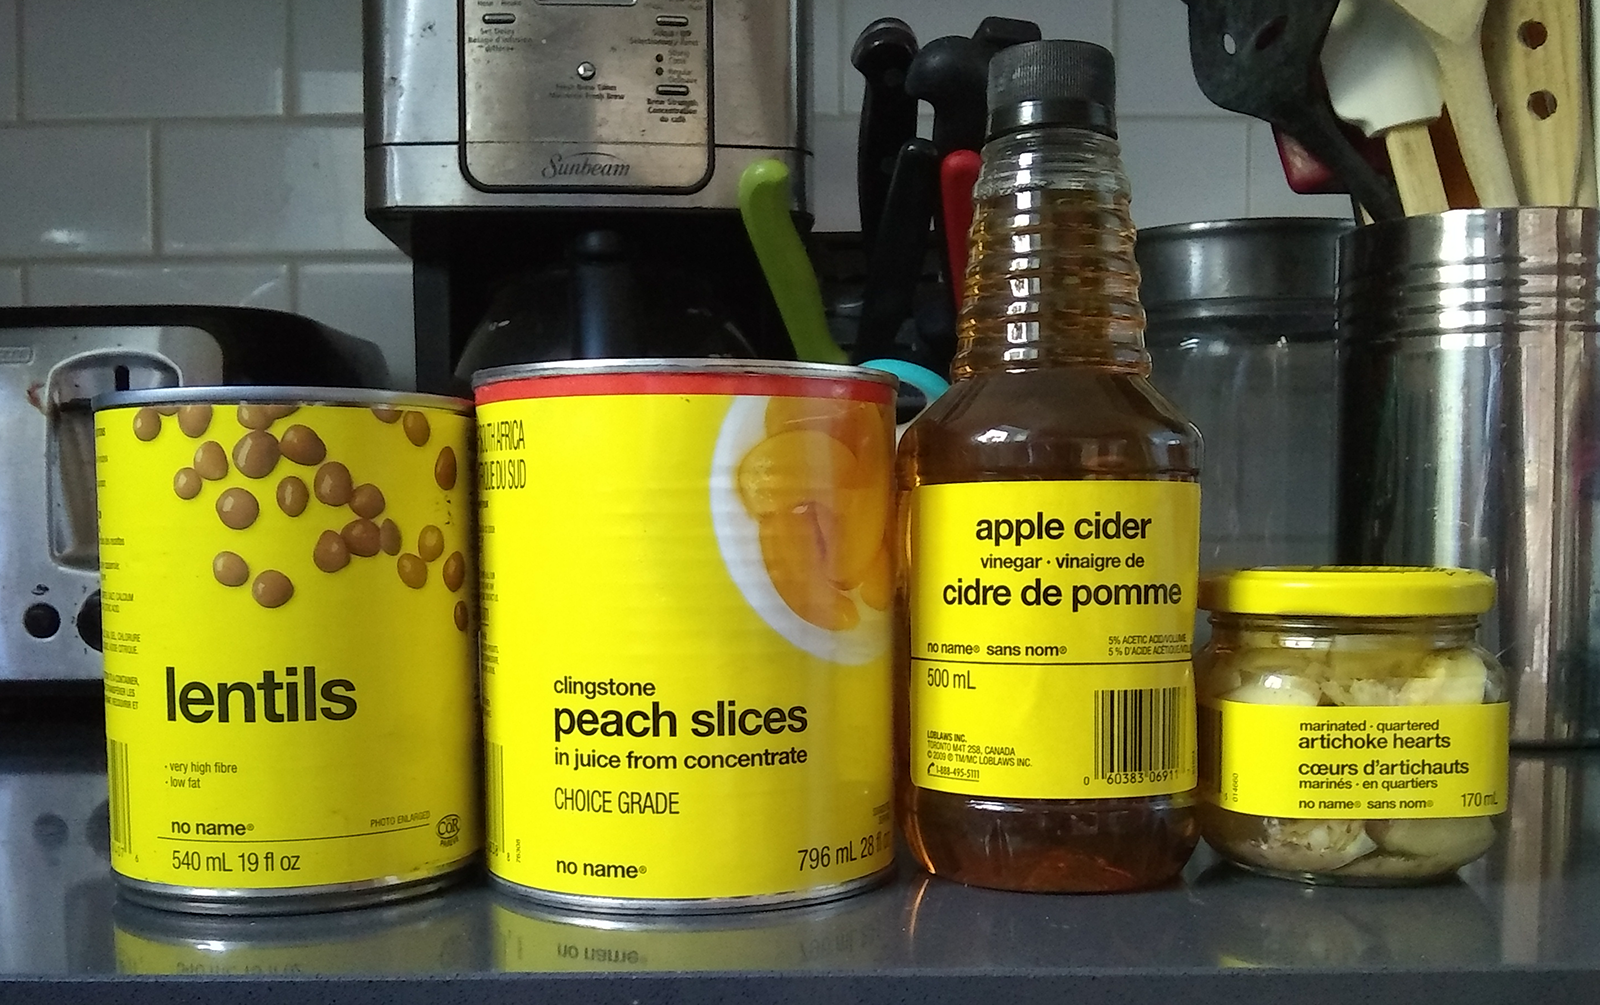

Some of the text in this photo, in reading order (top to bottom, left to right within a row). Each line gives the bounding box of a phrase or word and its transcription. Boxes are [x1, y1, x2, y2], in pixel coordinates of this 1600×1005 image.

[541, 153, 631, 179] Sunbeam
[496, 419, 526, 451] AFRICA
[507, 458, 527, 490] SUD
[975, 511, 1152, 547] apple cider
[980, 552, 1145, 572] vinegar vinaigre de
[942, 578, 1183, 613] cidre de pomme
[1122, 634, 1148, 645] ACETIC
[927, 641, 940, 654] no
[986, 644, 1022, 657] sans
[1107, 647, 1114, 656] 5
[1124, 645, 1152, 656] D'ACIDE
[553, 675, 656, 700] clingstone
[926, 668, 977, 690] 500 mL
[165, 666, 359, 724] lentils
[554, 700, 809, 742] peach slices
[1299, 719, 1440, 734] marinated quartered
[926, 730, 968, 743] LOBLAWS INC.
[1298, 733, 1451, 750] artichoke hearts
[926, 740, 952, 752] TORONTO
[952, 742, 966, 752] M4T
[984, 746, 1016, 756] CANADA
[554, 747, 809, 771] in juice from concentrate
[933, 751, 946, 761] 2009
[955, 754, 978, 764] TM/MC
[978, 756, 1015, 767] LOBLAWS
[1016, 758, 1033, 768] INC.
[1298, 759, 1470, 776] cœurs d'artichauts
[169, 761, 238, 776] very high fibre
[170, 776, 202, 789] low fat
[1083, 769, 1179, 786] 0 60383 06911
[1298, 776, 1438, 792] marinés en quartiers
[554, 786, 680, 815] CHOICE GRADE
[1298, 800, 1316, 810] no
[1366, 799, 1397, 810] sans
[1460, 791, 1499, 808] 170 mL
[171, 821, 191, 834] no
[172, 850, 301, 873] 540 mL 19 fl oz
[797, 845, 831, 872] 796
[835, 840, 858, 866] mL
[860, 834, 875, 860] 28
[556, 859, 578, 875] no
